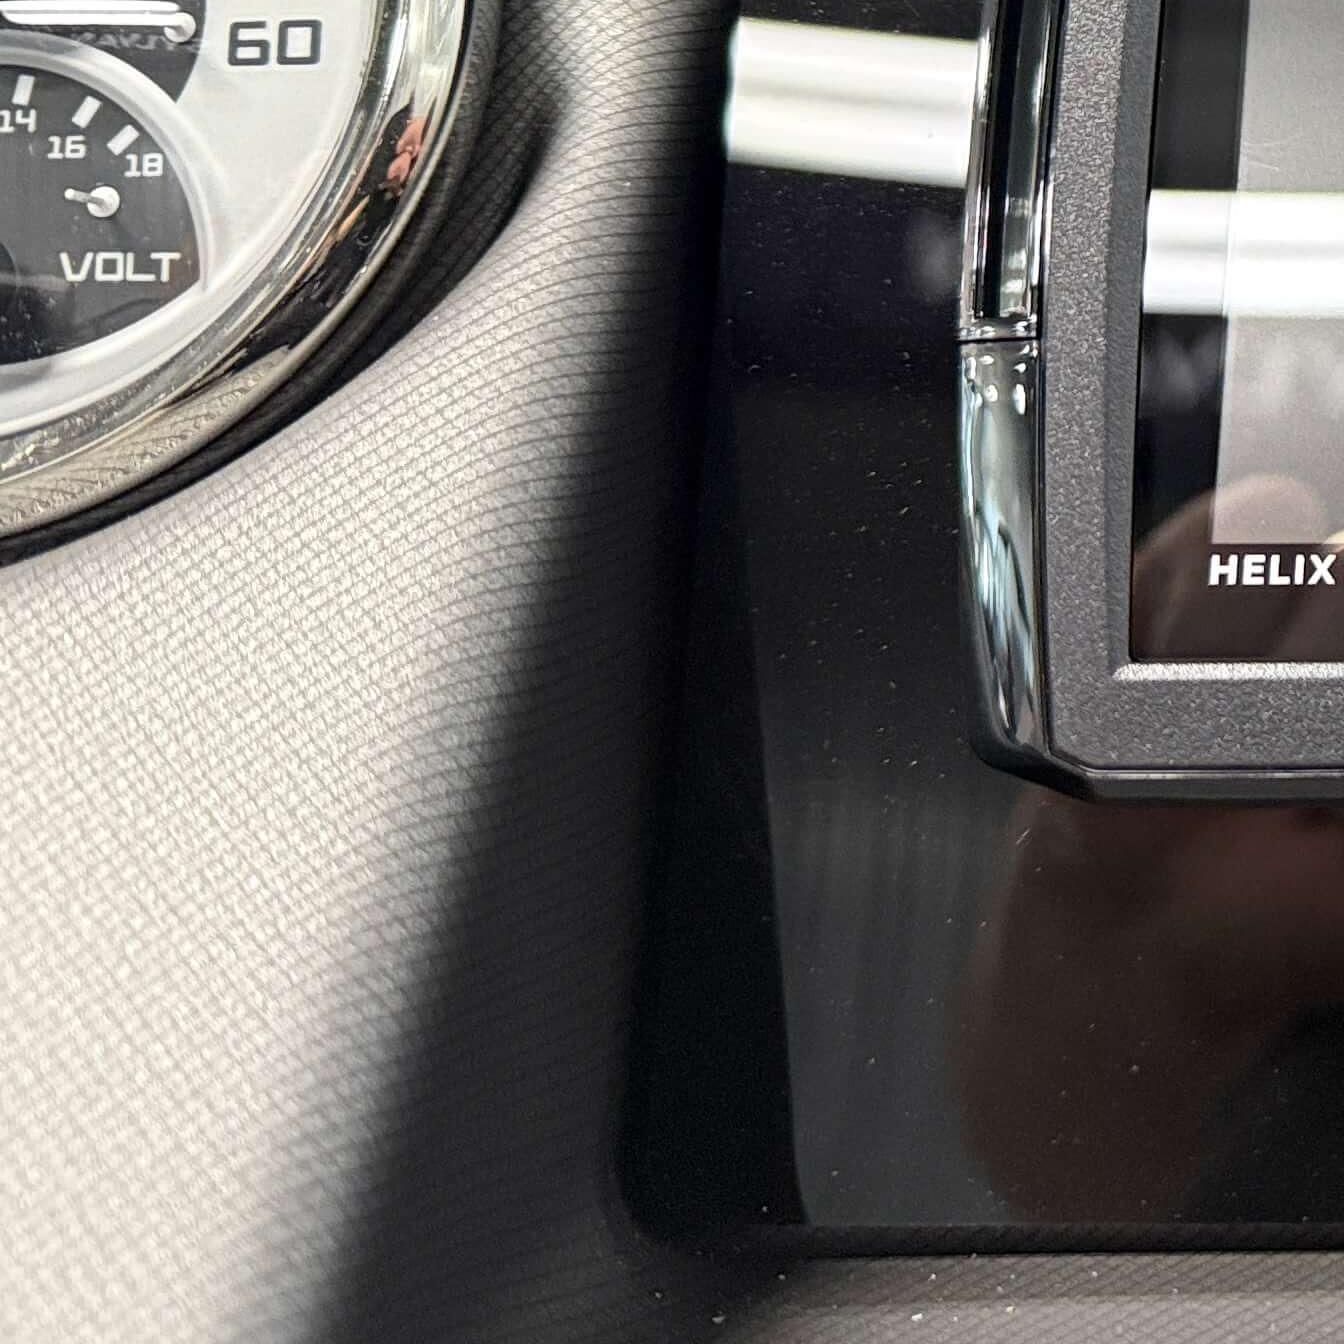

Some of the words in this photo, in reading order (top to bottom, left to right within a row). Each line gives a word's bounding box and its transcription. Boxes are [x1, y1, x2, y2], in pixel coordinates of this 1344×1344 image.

[227, 19, 322, 66] 60
[0, 109, 37, 133] 14
[47, 136, 86, 159] 16
[124, 153, 164, 177] 18
[59, 252, 181, 282] VOLT
[1208, 554, 1337, 586] HELIX
